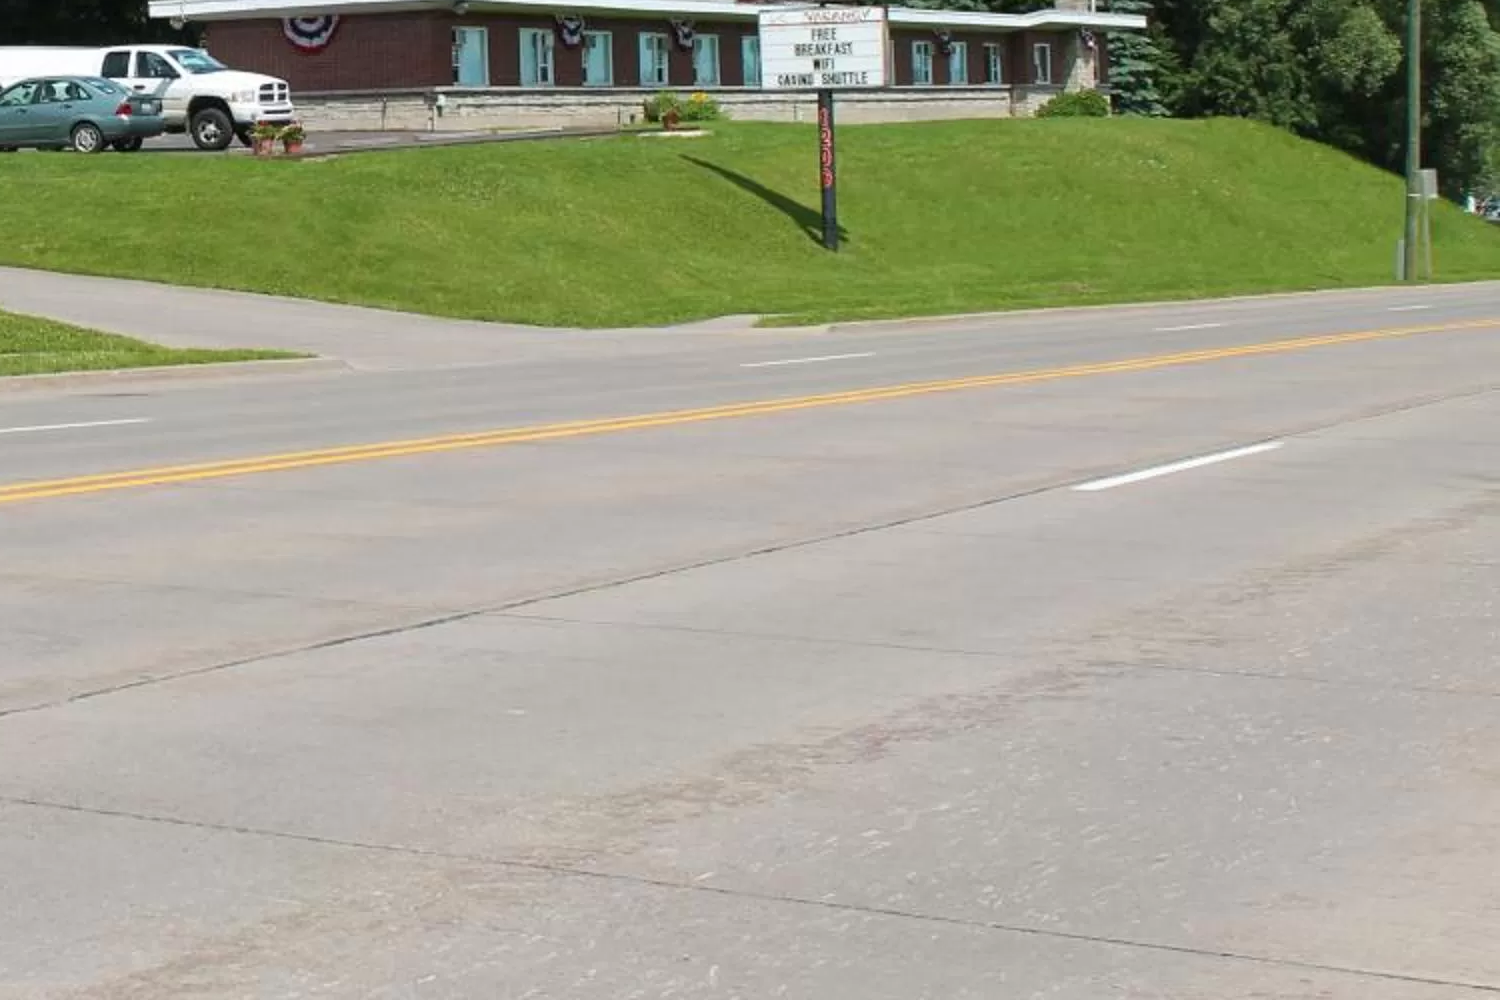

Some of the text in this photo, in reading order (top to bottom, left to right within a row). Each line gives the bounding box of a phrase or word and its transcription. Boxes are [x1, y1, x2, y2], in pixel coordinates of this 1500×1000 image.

[811, 28, 837, 41] FREE
[794, 42, 853, 56] BREAKFAST
[813, 57, 835, 70] WIFI
[777, 72, 869, 86] CASINO SHUTTLE
